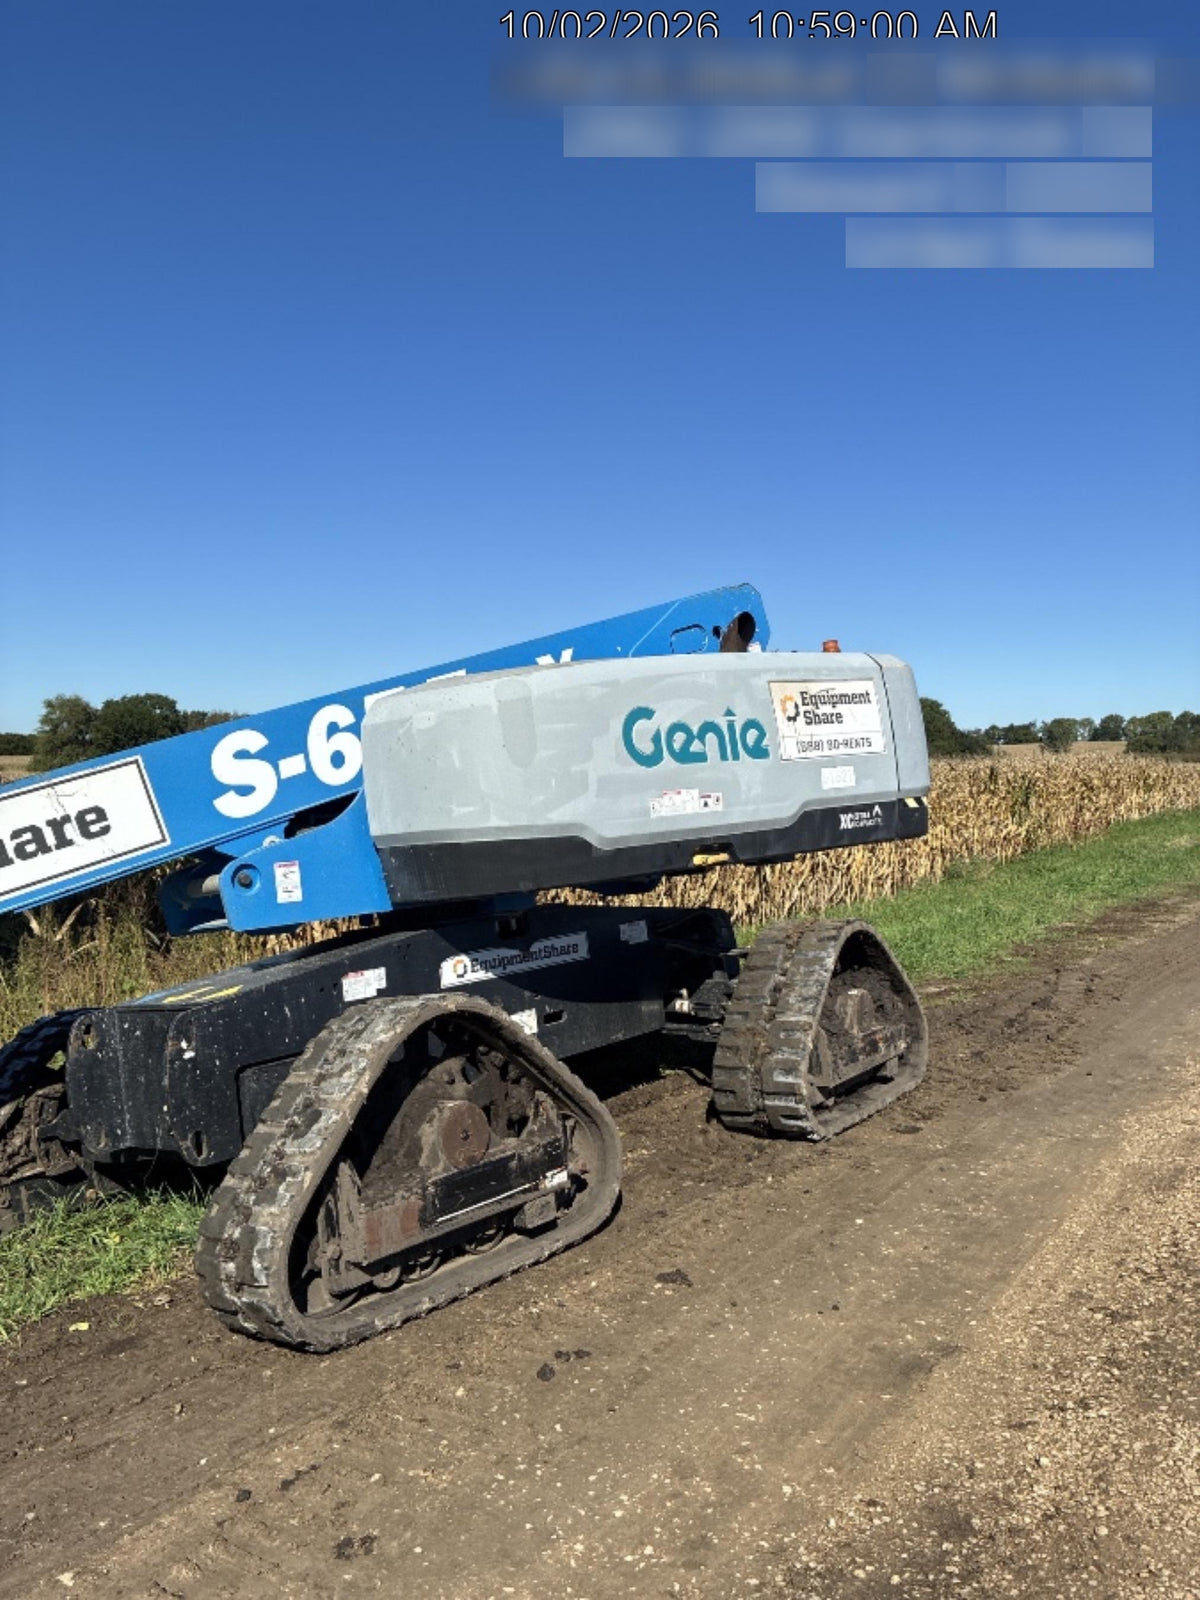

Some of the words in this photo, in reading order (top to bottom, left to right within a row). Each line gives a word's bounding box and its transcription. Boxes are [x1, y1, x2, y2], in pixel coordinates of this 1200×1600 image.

[799, 689, 873, 710] Equipment
[803, 708, 844, 726] Share
[210, 686, 404, 819] S-6
[621, 705, 770, 768] Genie
